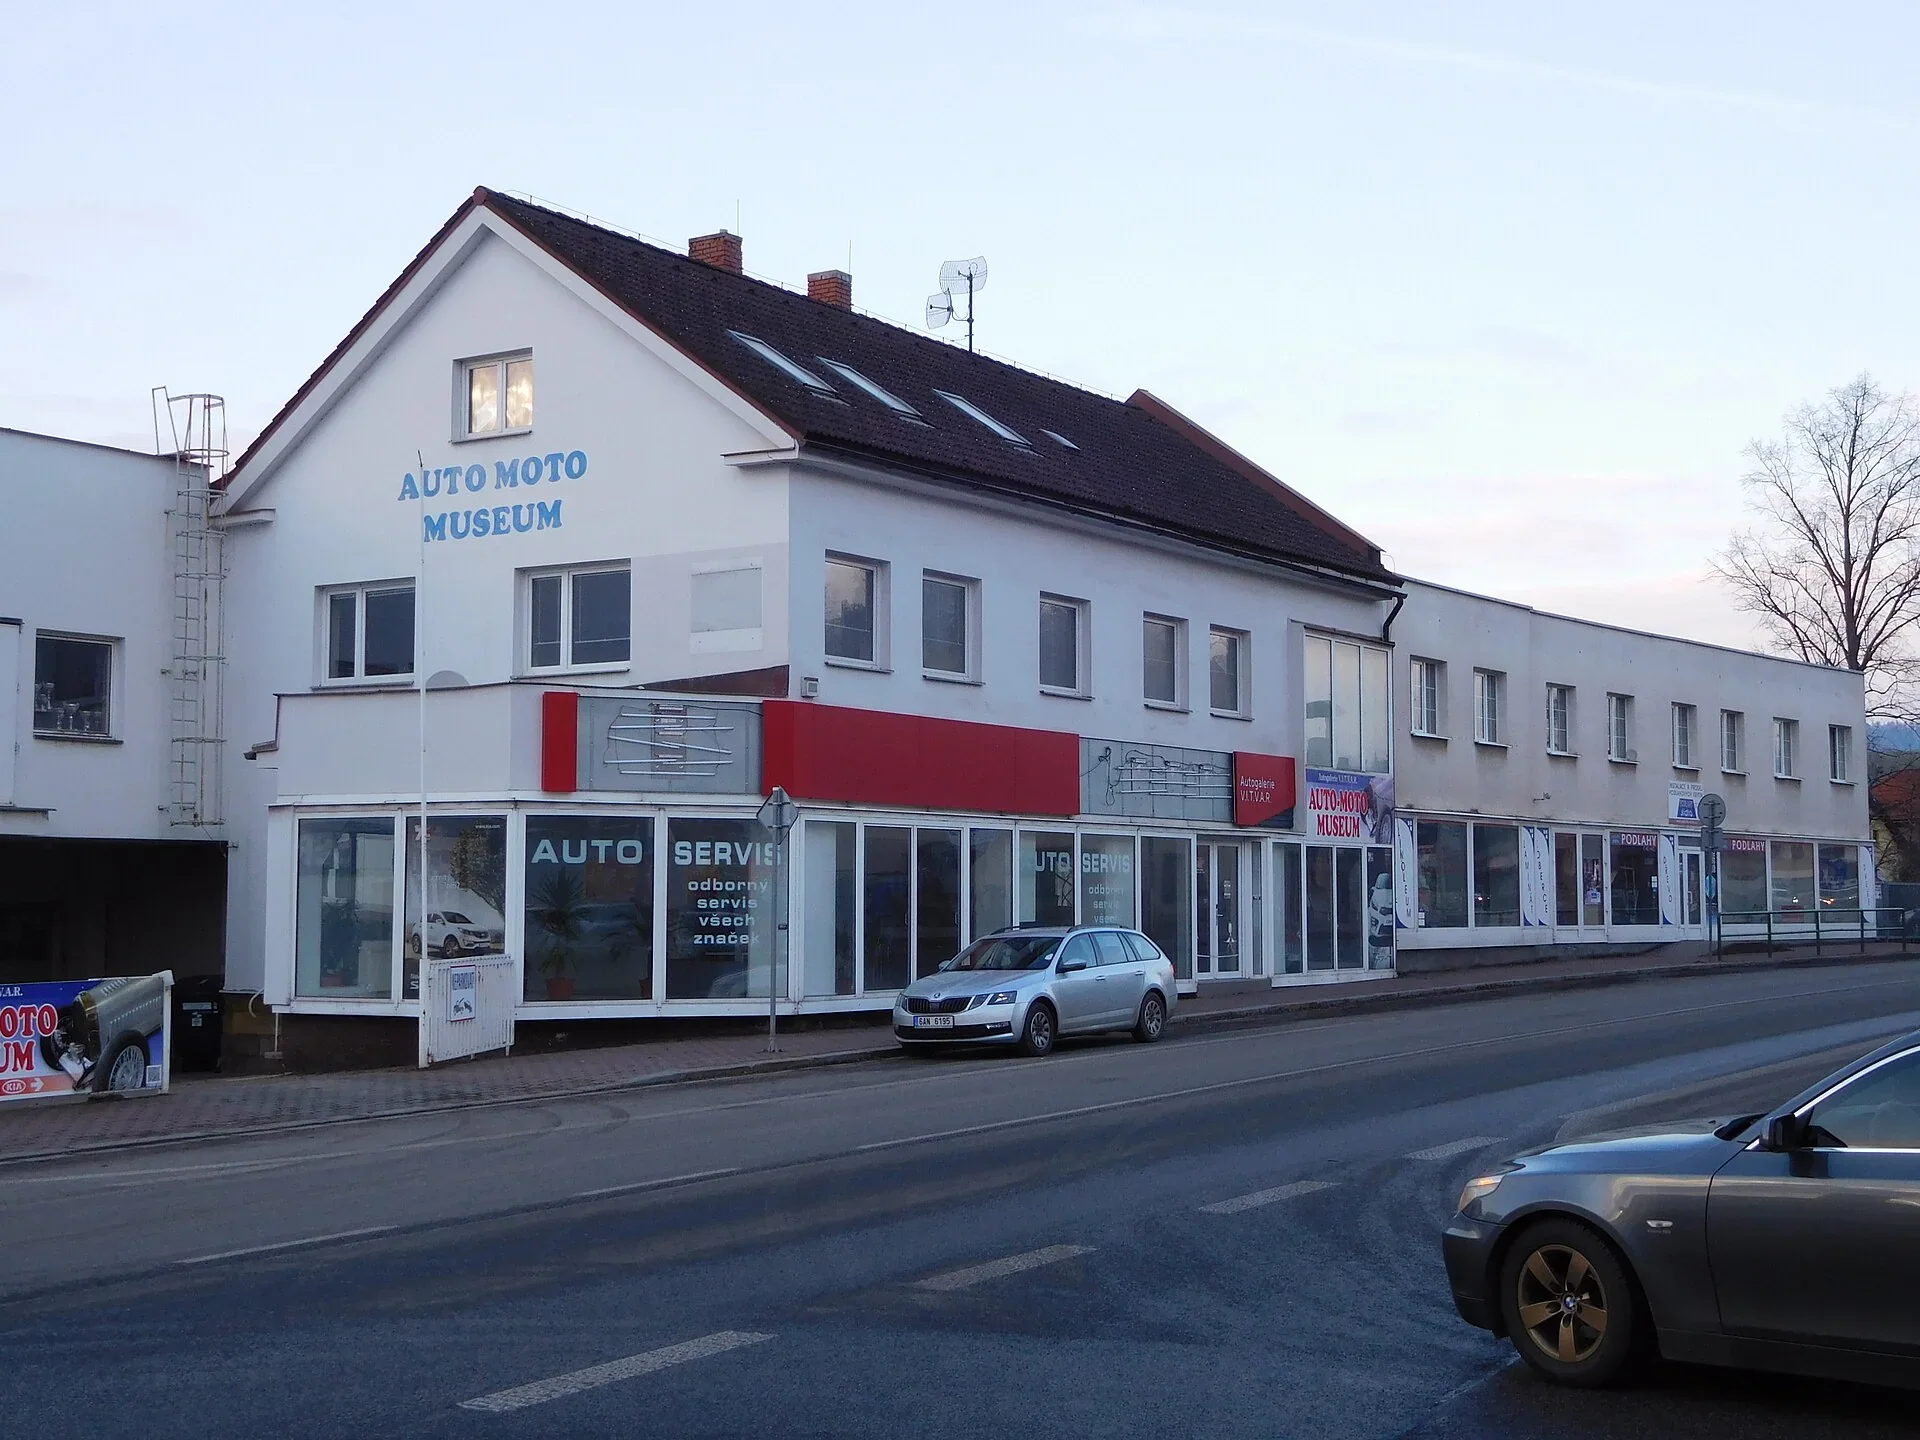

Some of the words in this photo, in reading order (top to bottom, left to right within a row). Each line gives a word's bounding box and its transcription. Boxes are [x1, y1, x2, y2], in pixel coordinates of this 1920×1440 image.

[397, 463, 487, 502] AUTO
[494, 449, 588, 490] MOTO
[423, 499, 563, 543] MUSEUM
[1240, 775, 1275, 790] Autogalerie
[1308, 787, 1369, 814] AUTO-MOTO
[1316, 814, 1360, 838] MUSEUM
[1621, 833, 1657, 847] PODLAHY
[1732, 839, 1765, 851] PODLAHY
[530, 839, 643, 864] AUTO
[674, 840, 781, 866] SERVIS
[1082, 852, 1131, 873] SERVIS
[1536, 839, 1549, 914] OBERCE
[687, 877, 769, 893] odborný
[697, 896, 759, 909] servis
[698, 913, 755, 927] všech
[693, 931, 760, 945] značek
[934, 1017, 951, 1025] 6195
[6, 1082, 23, 1092] KIA
